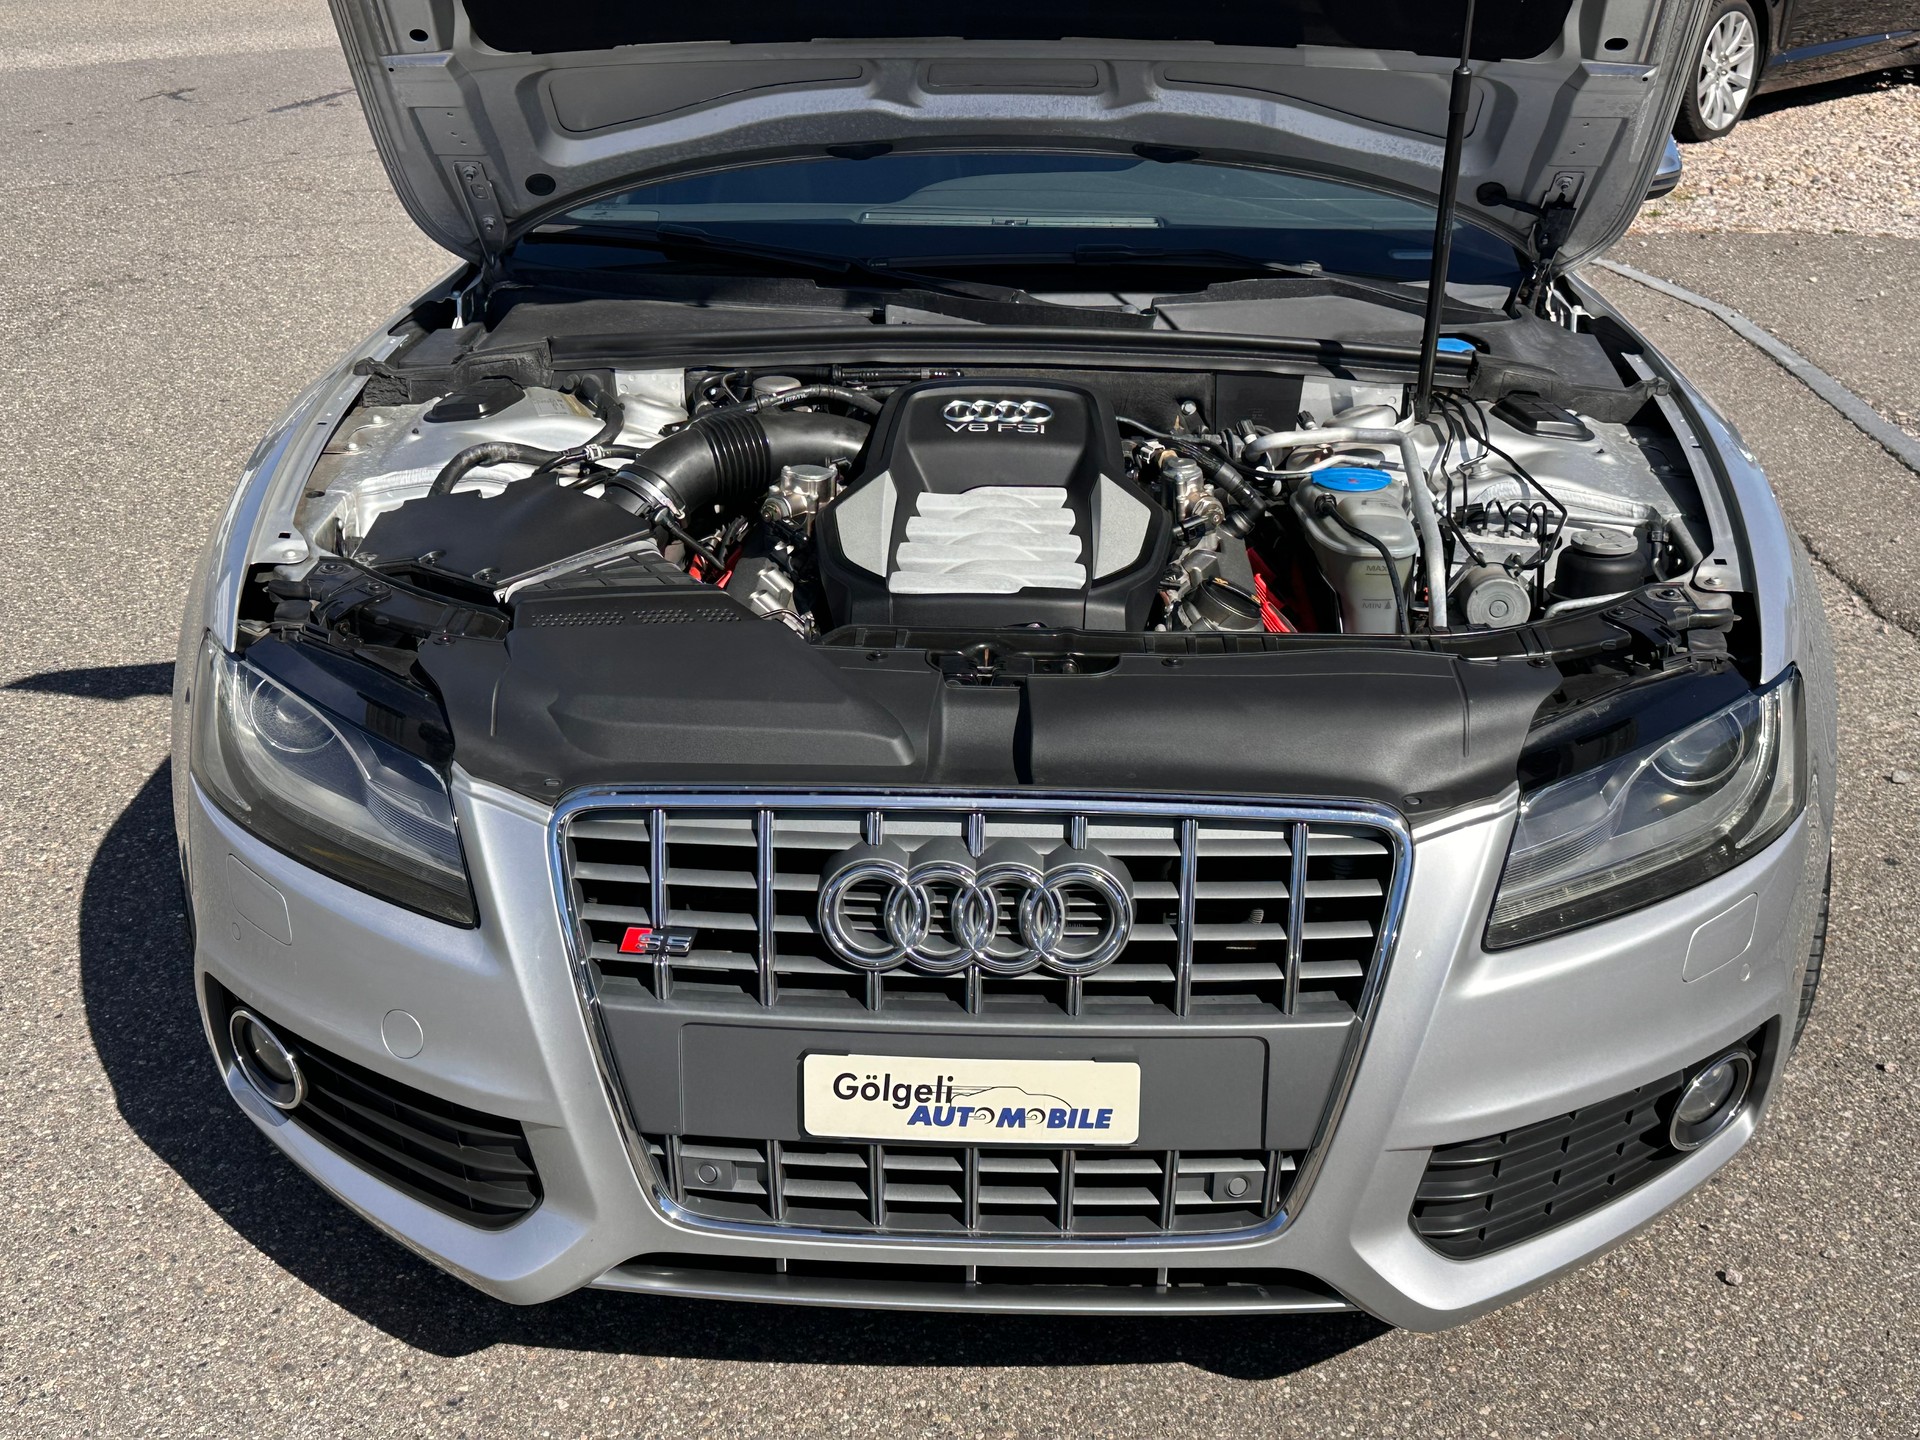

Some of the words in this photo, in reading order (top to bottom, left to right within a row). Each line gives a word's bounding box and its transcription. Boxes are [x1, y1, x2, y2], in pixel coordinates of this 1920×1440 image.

[946, 423, 989, 432] V8
[997, 423, 1045, 434] FSI
[635, 933, 692, 953] S5
[833, 1072, 954, 1110] Gölgeli
[907, 1105, 1113, 1129] AUTOMOBILE
